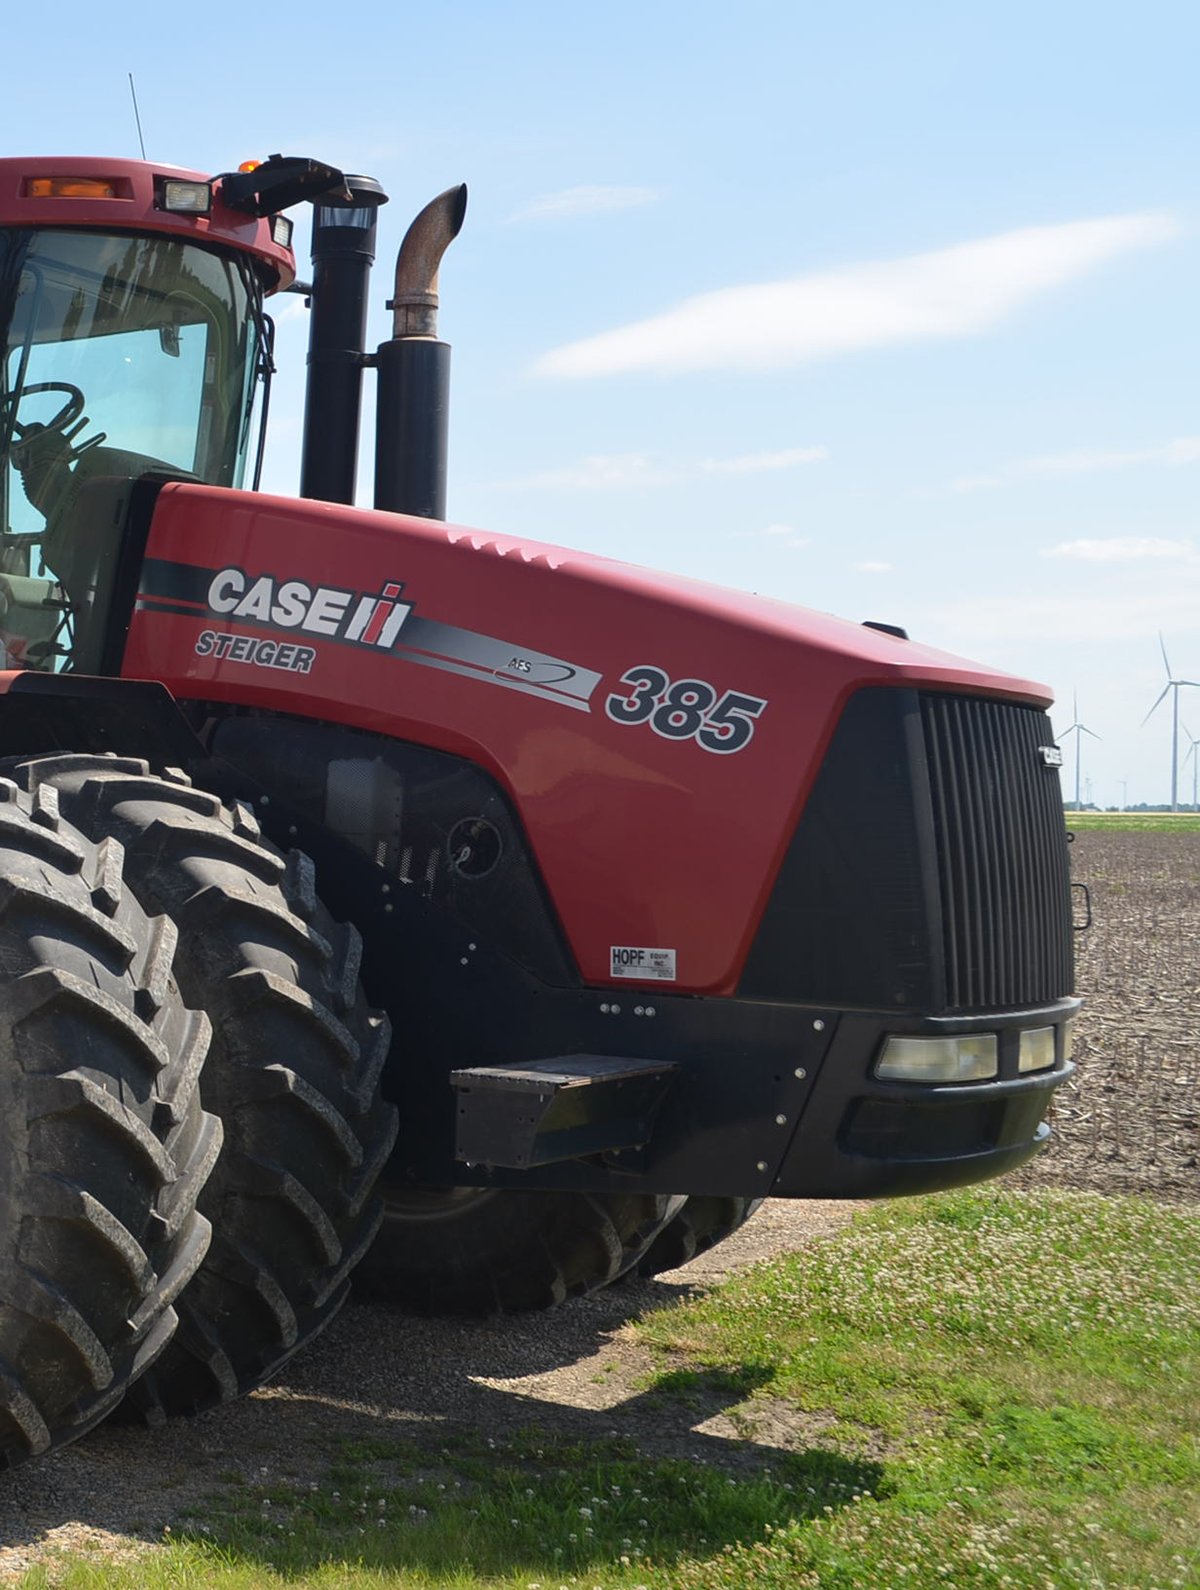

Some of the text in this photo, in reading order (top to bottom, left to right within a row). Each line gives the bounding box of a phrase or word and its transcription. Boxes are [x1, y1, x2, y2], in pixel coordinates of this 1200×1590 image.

[207, 568, 353, 636] CASE
[195, 629, 317, 674] STEIGER
[507, 657, 532, 673] AFS
[604, 664, 769, 755] 385
[612, 948, 645, 965] HOPF
